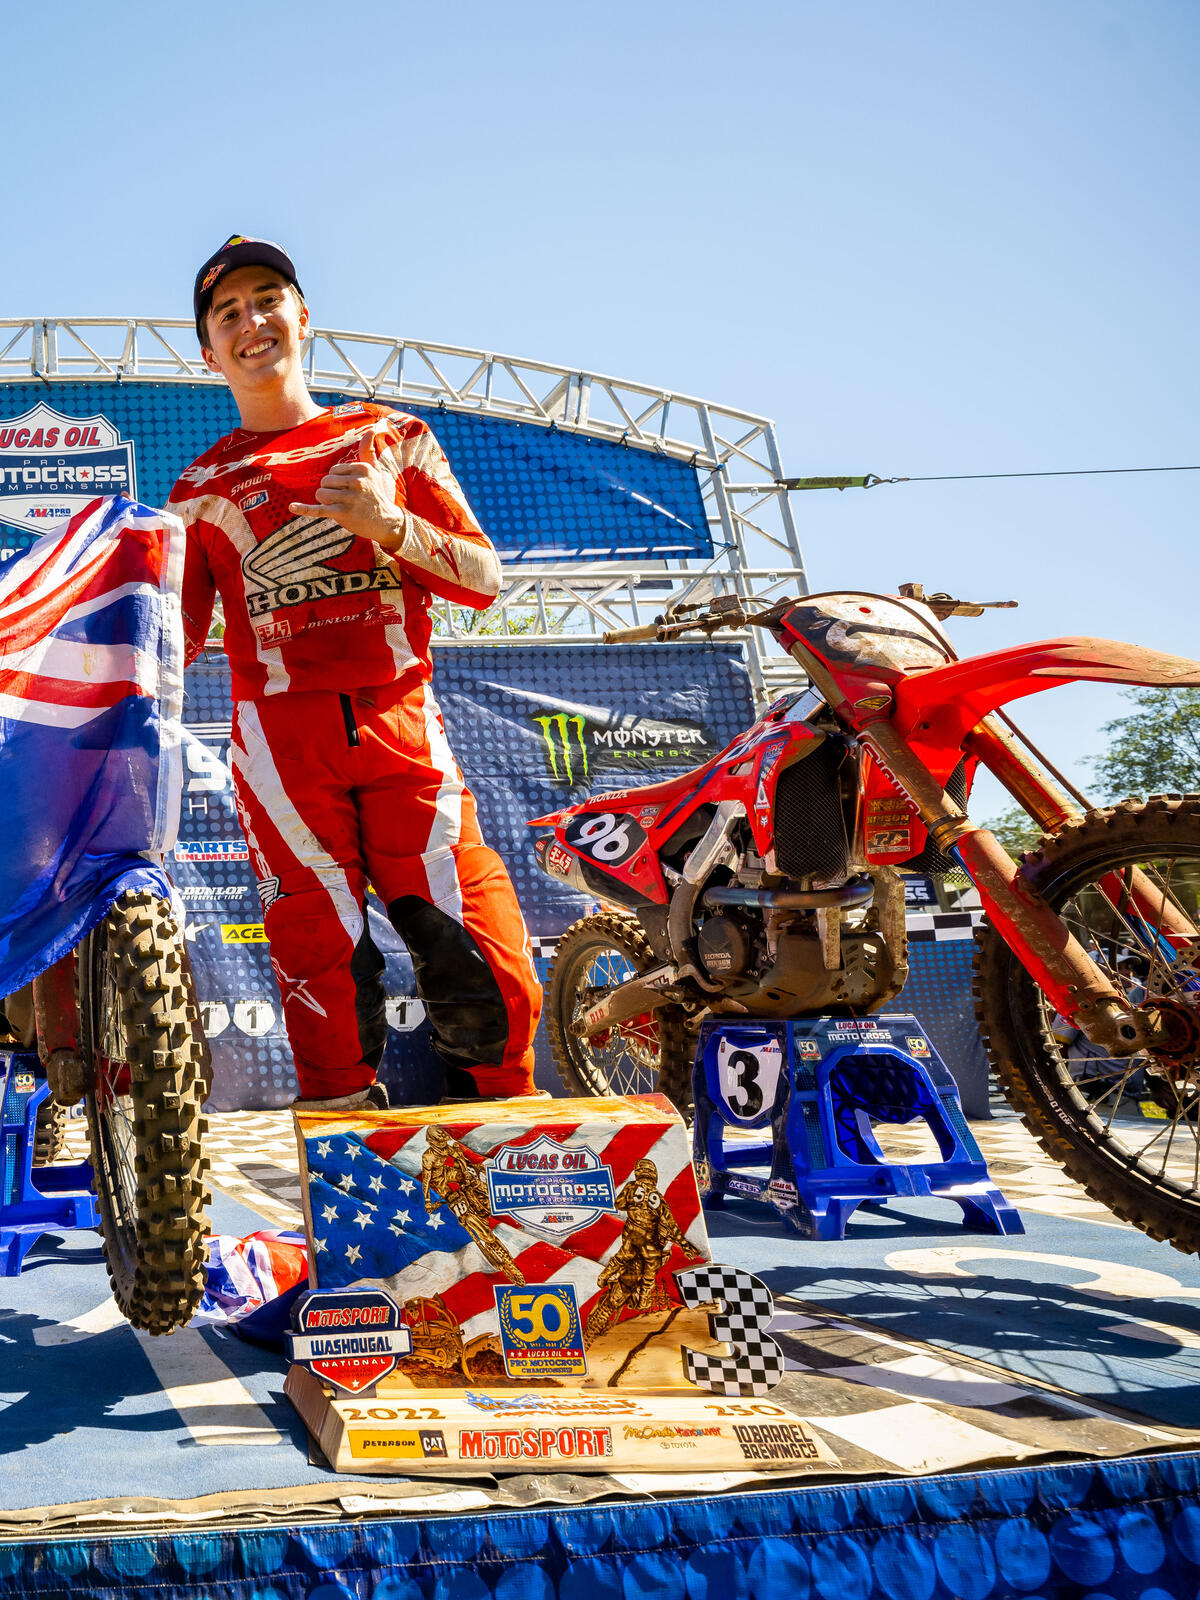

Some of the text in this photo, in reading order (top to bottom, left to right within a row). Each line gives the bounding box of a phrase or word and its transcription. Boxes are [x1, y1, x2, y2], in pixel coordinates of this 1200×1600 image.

[64, 426, 101, 447] OIL
[23, 458, 66, 466] PRO
[230, 472, 272, 498] SHOWA
[242, 493, 265, 510] 100%
[24, 507, 54, 518] AMA
[249, 567, 400, 616] HONDA
[307, 613, 360, 630] DUNLOP
[592, 727, 708, 748] MONSTER
[613, 749, 691, 759] ENERGY
[588, 790, 628, 805] HONDA
[568, 813, 630, 861] 96
[176, 841, 248, 853] PARTS
[176, 852, 249, 861] UNLIMITED
[182, 886, 248, 896] DUNLOP
[837, 1022, 862, 1030] LUCAS
[827, 1032, 892, 1041] MOTOCROSS
[800, 1041, 816, 1053] 50
[909, 1039, 926, 1051] 50
[17, 1073, 33, 1086] 50
[727, 1049, 763, 1117] 3
[506, 1153, 589, 1170] LUCAS OIL
[494, 1183, 610, 1197] MOTOCROSS
[495, 1196, 612, 1204] CHAMPIONSHIP
[632, 1186, 661, 1209] 59
[509, 1293, 571, 1343] 50
[672, 1264, 785, 1396] 3
[310, 1336, 393, 1356] WASHOUGAL
[527, 1350, 562, 1358] LUCAS OIL
[321, 1358, 386, 1368] NATIONAL
[509, 1358, 583, 1368] PRO MOTOCROSS
[342, 1407, 446, 1421] 2022
[704, 1404, 786, 1417] 250
[363, 1437, 444, 1453] PETERSON CAT
[670, 1440, 698, 1449] TOYOTA
